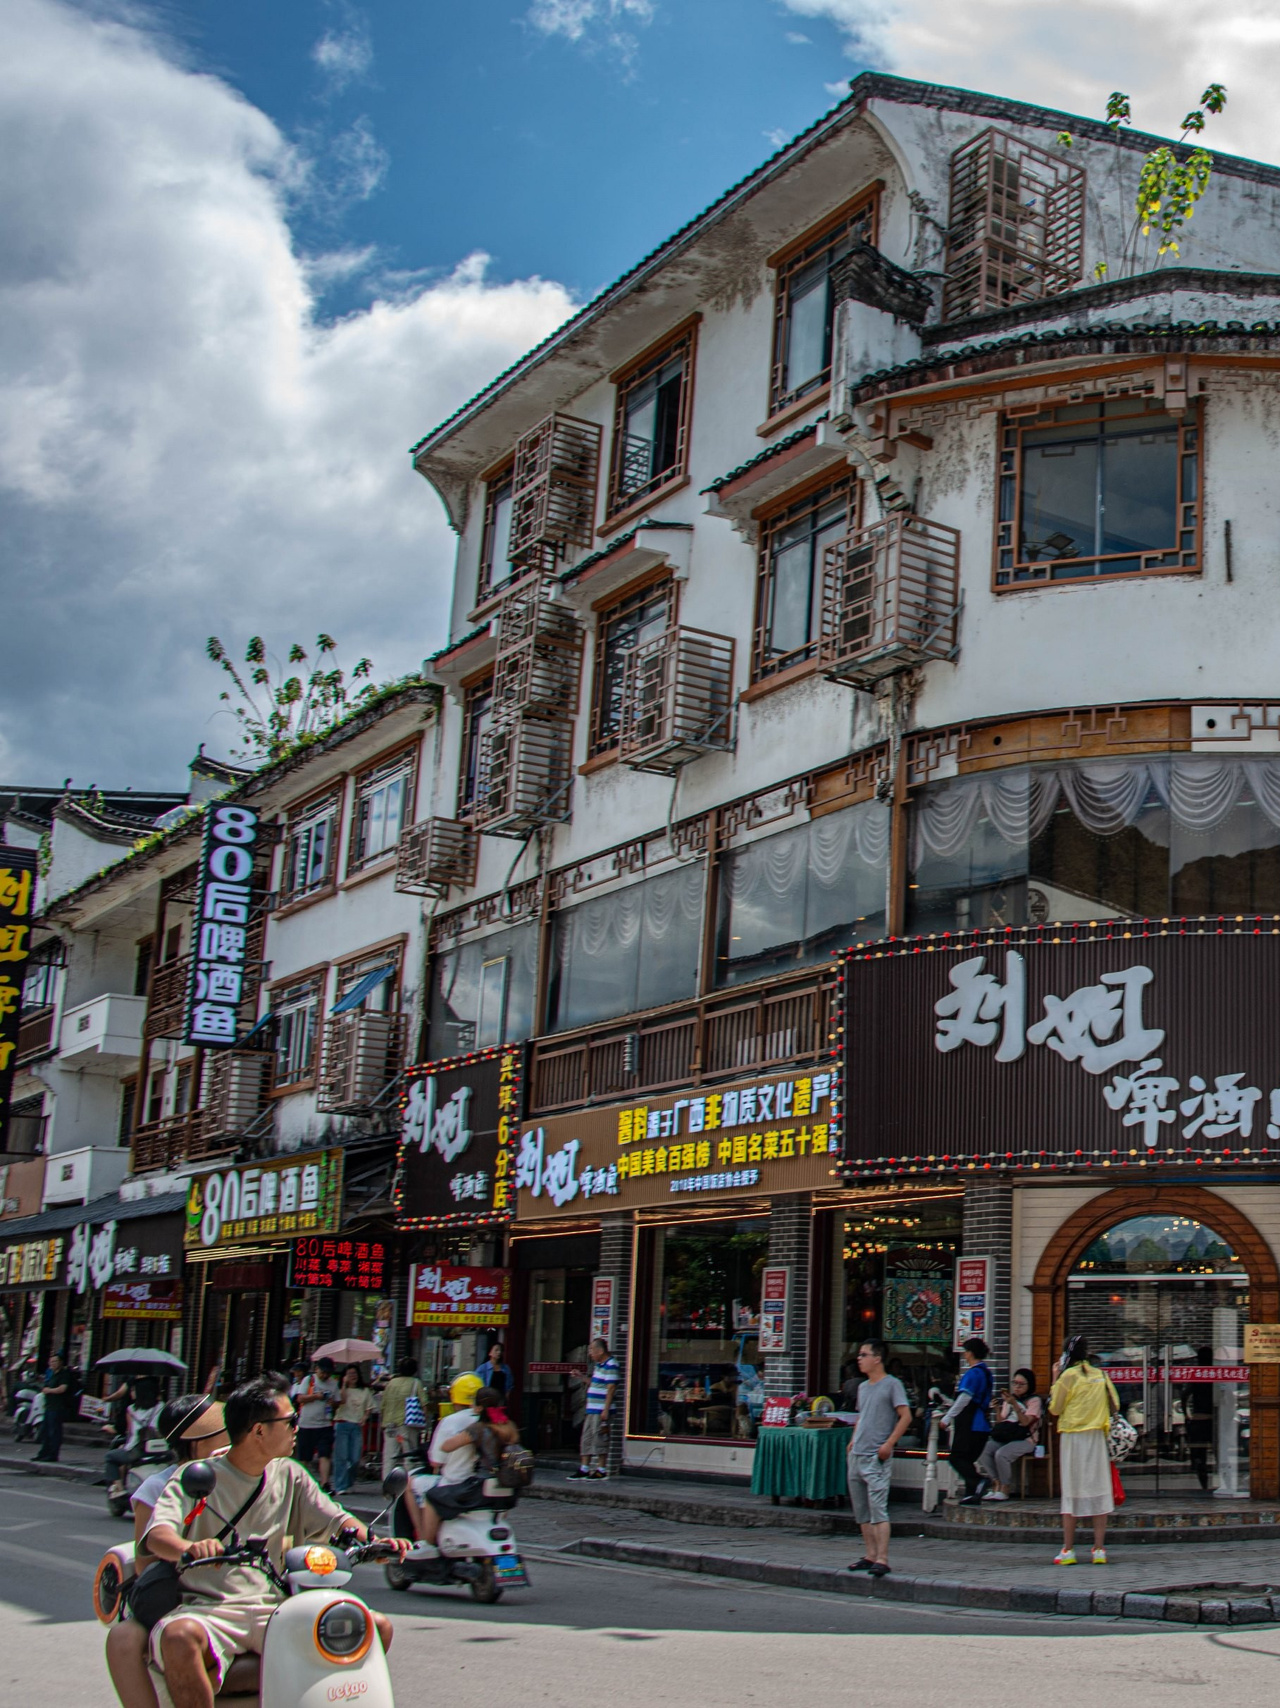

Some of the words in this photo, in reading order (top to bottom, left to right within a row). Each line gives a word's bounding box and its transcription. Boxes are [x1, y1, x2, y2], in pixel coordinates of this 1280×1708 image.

[191, 806, 257, 1043] 80后啤酒鱼
[934, 950, 1165, 1074] 刘姐
[493, 1055, 513, 1208] 兴坪6分店
[618, 1074, 830, 1145] 酱料源于广西非物质文化遗产
[617, 1141, 711, 1180] 中国美食百强榜
[718, 1123, 828, 1166] 中国名菜五十强
[201, 1164, 319, 1246] 80后啤酒鱼
[296, 1238, 385, 1259] 80后啤酒鱼
